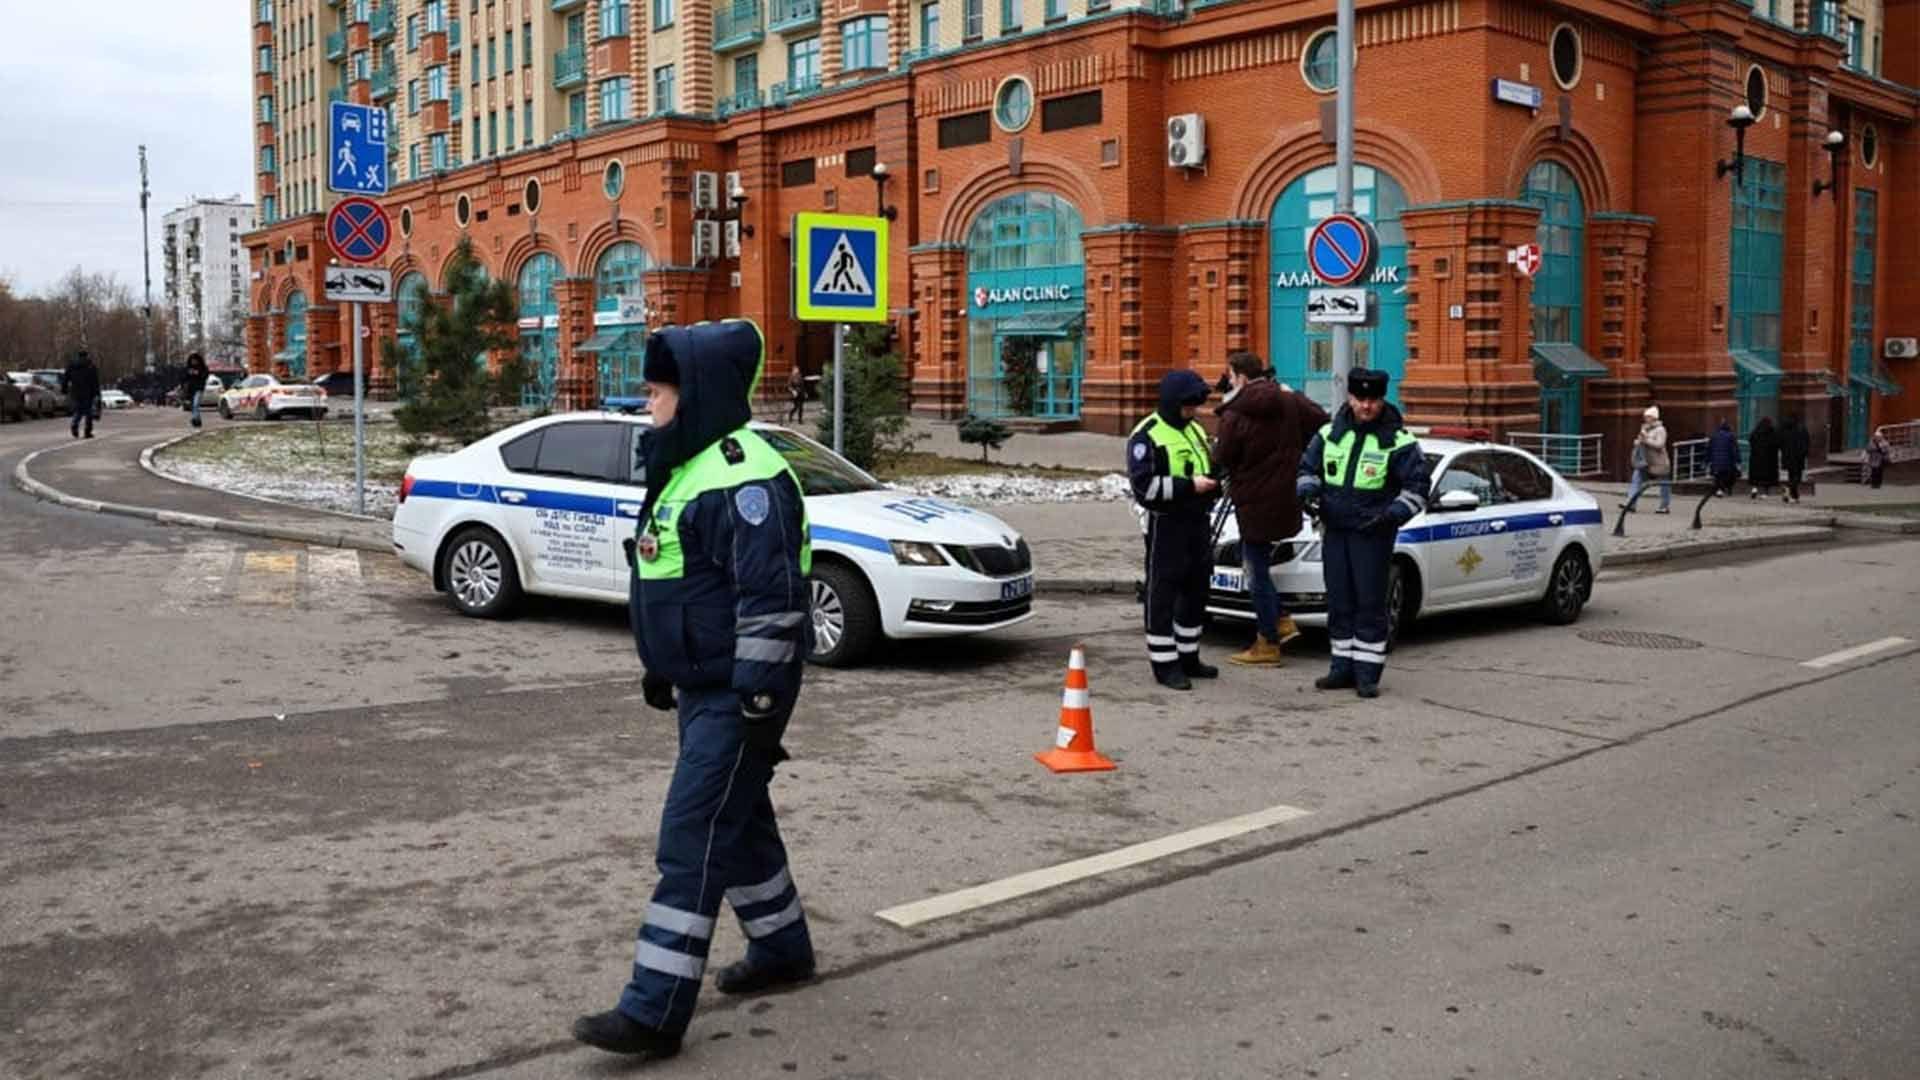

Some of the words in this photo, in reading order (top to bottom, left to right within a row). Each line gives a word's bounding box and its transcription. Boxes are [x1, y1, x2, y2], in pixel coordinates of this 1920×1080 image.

[1277, 269, 1321, 287] АЛАН
[988, 287, 1020, 303] ALAN
[1023, 283, 1071, 301] CLINIC
[883, 499, 972, 523] ДПС
